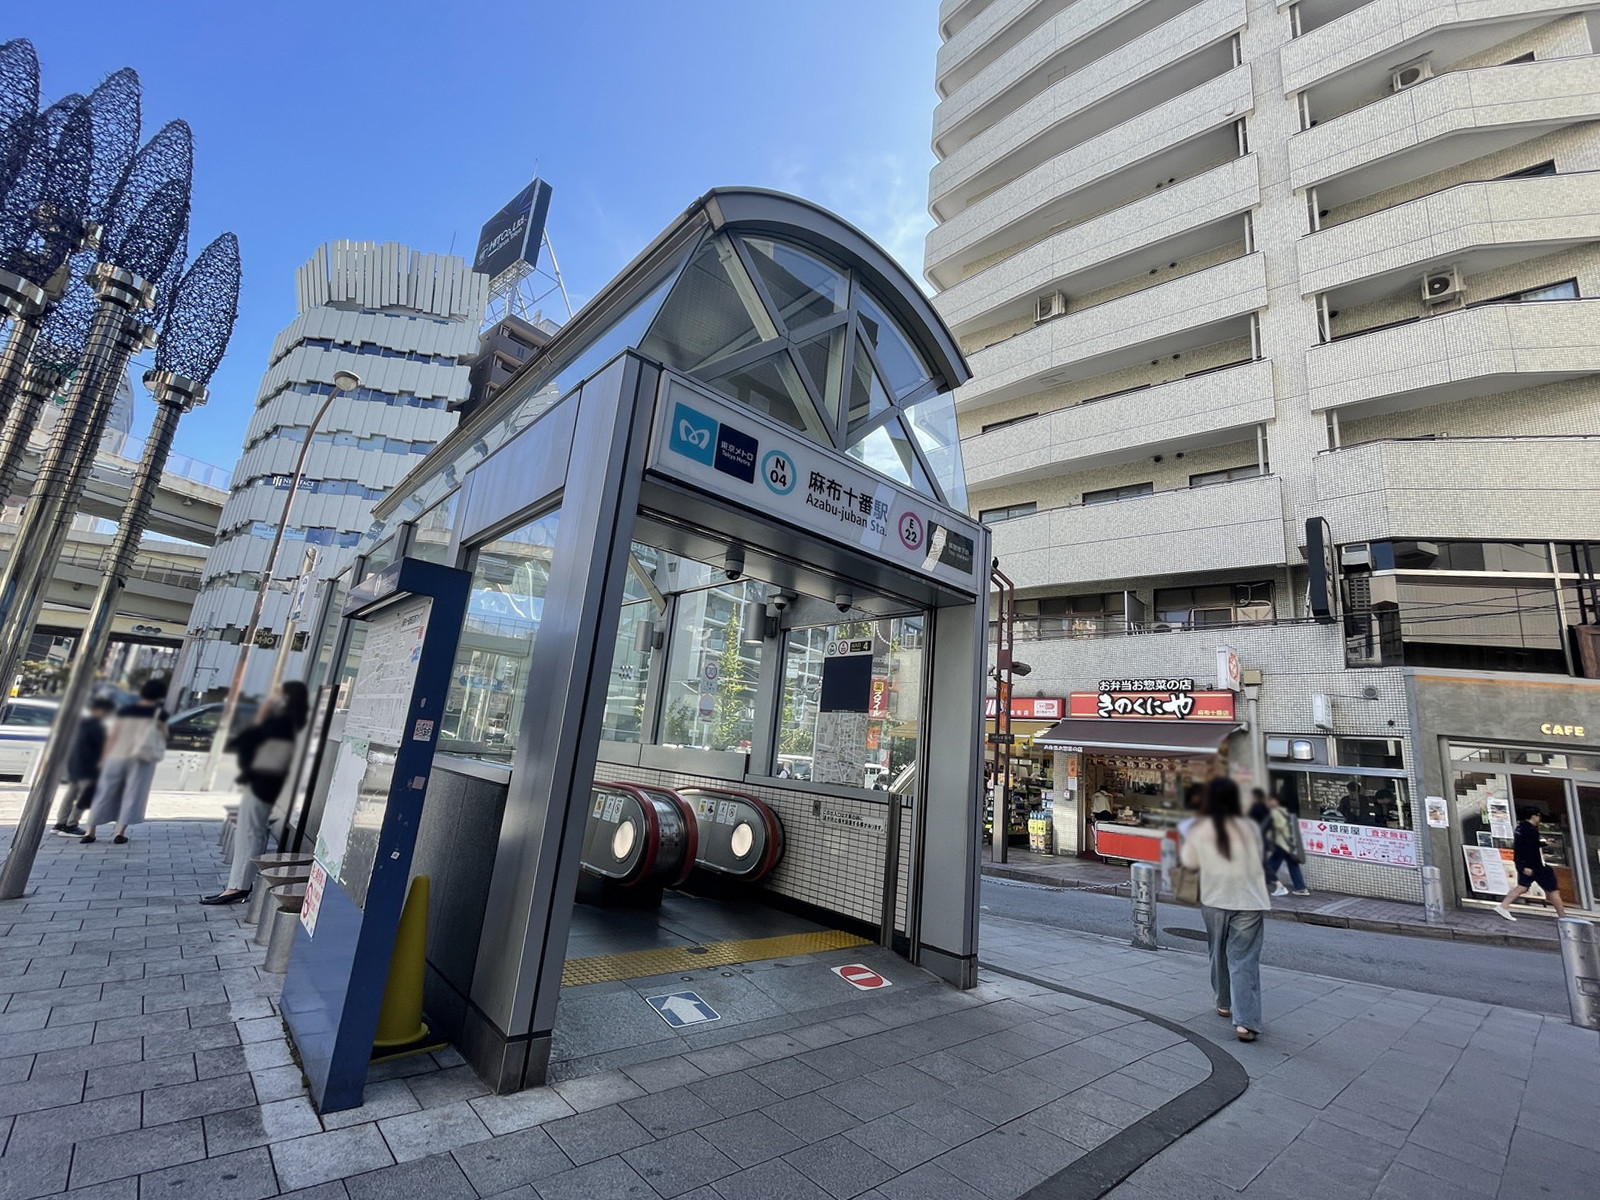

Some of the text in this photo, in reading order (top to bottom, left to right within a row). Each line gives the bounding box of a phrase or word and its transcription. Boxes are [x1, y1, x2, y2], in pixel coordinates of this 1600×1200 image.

[720, 440, 755, 462] 東京メトロ
[775, 457, 786, 472] N
[770, 469, 787, 488] 04
[808, 471, 888, 523] 麻布十番駅
[806, 493, 888, 537] Azabu-juban Sta.
[909, 519, 915, 529] E
[905, 529, 917, 543] 22
[863, 642, 869, 650] 4
[1099, 679, 1192, 691] お弁当お惣菜の店
[1097, 692, 1194, 719] きのくにや
[1540, 723, 1585, 737] CAFE
